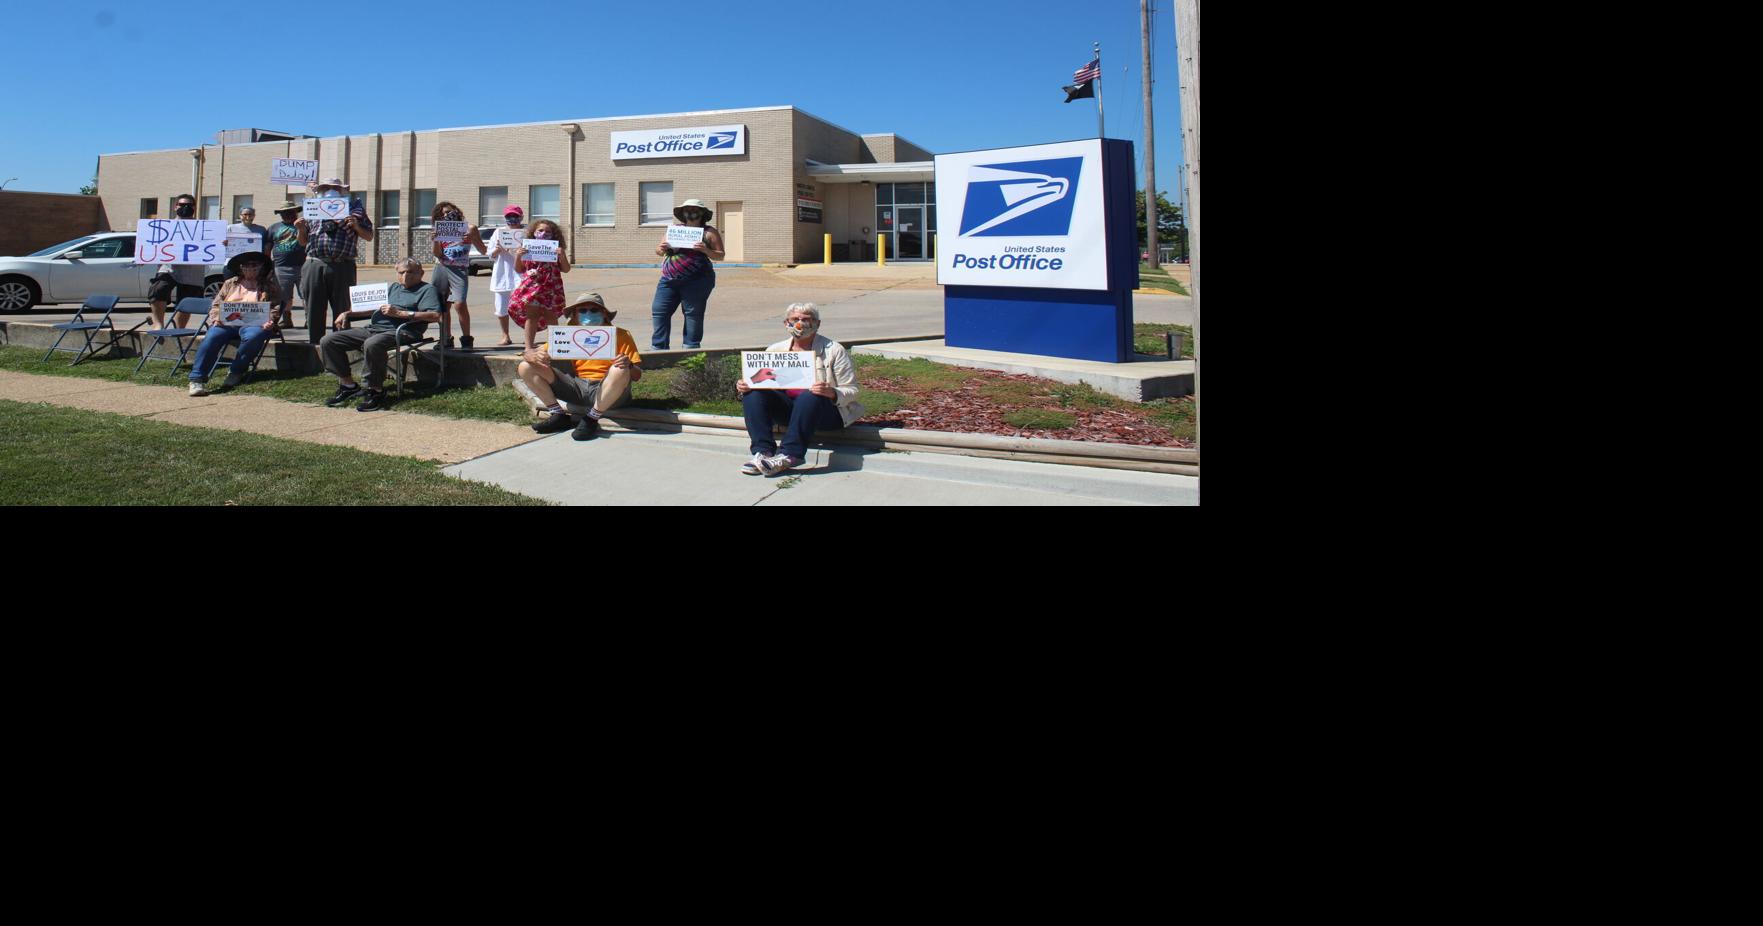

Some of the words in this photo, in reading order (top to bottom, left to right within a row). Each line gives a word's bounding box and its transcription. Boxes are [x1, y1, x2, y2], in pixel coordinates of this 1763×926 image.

[616, 142, 652, 153] Post
[654, 140, 703, 152] Office
[280, 160, 315, 170] DUMP
[952, 254, 997, 269] Post
[998, 254, 1063, 270] Office
[746, 353, 772, 361] DON'T
[774, 353, 799, 361] MESS
